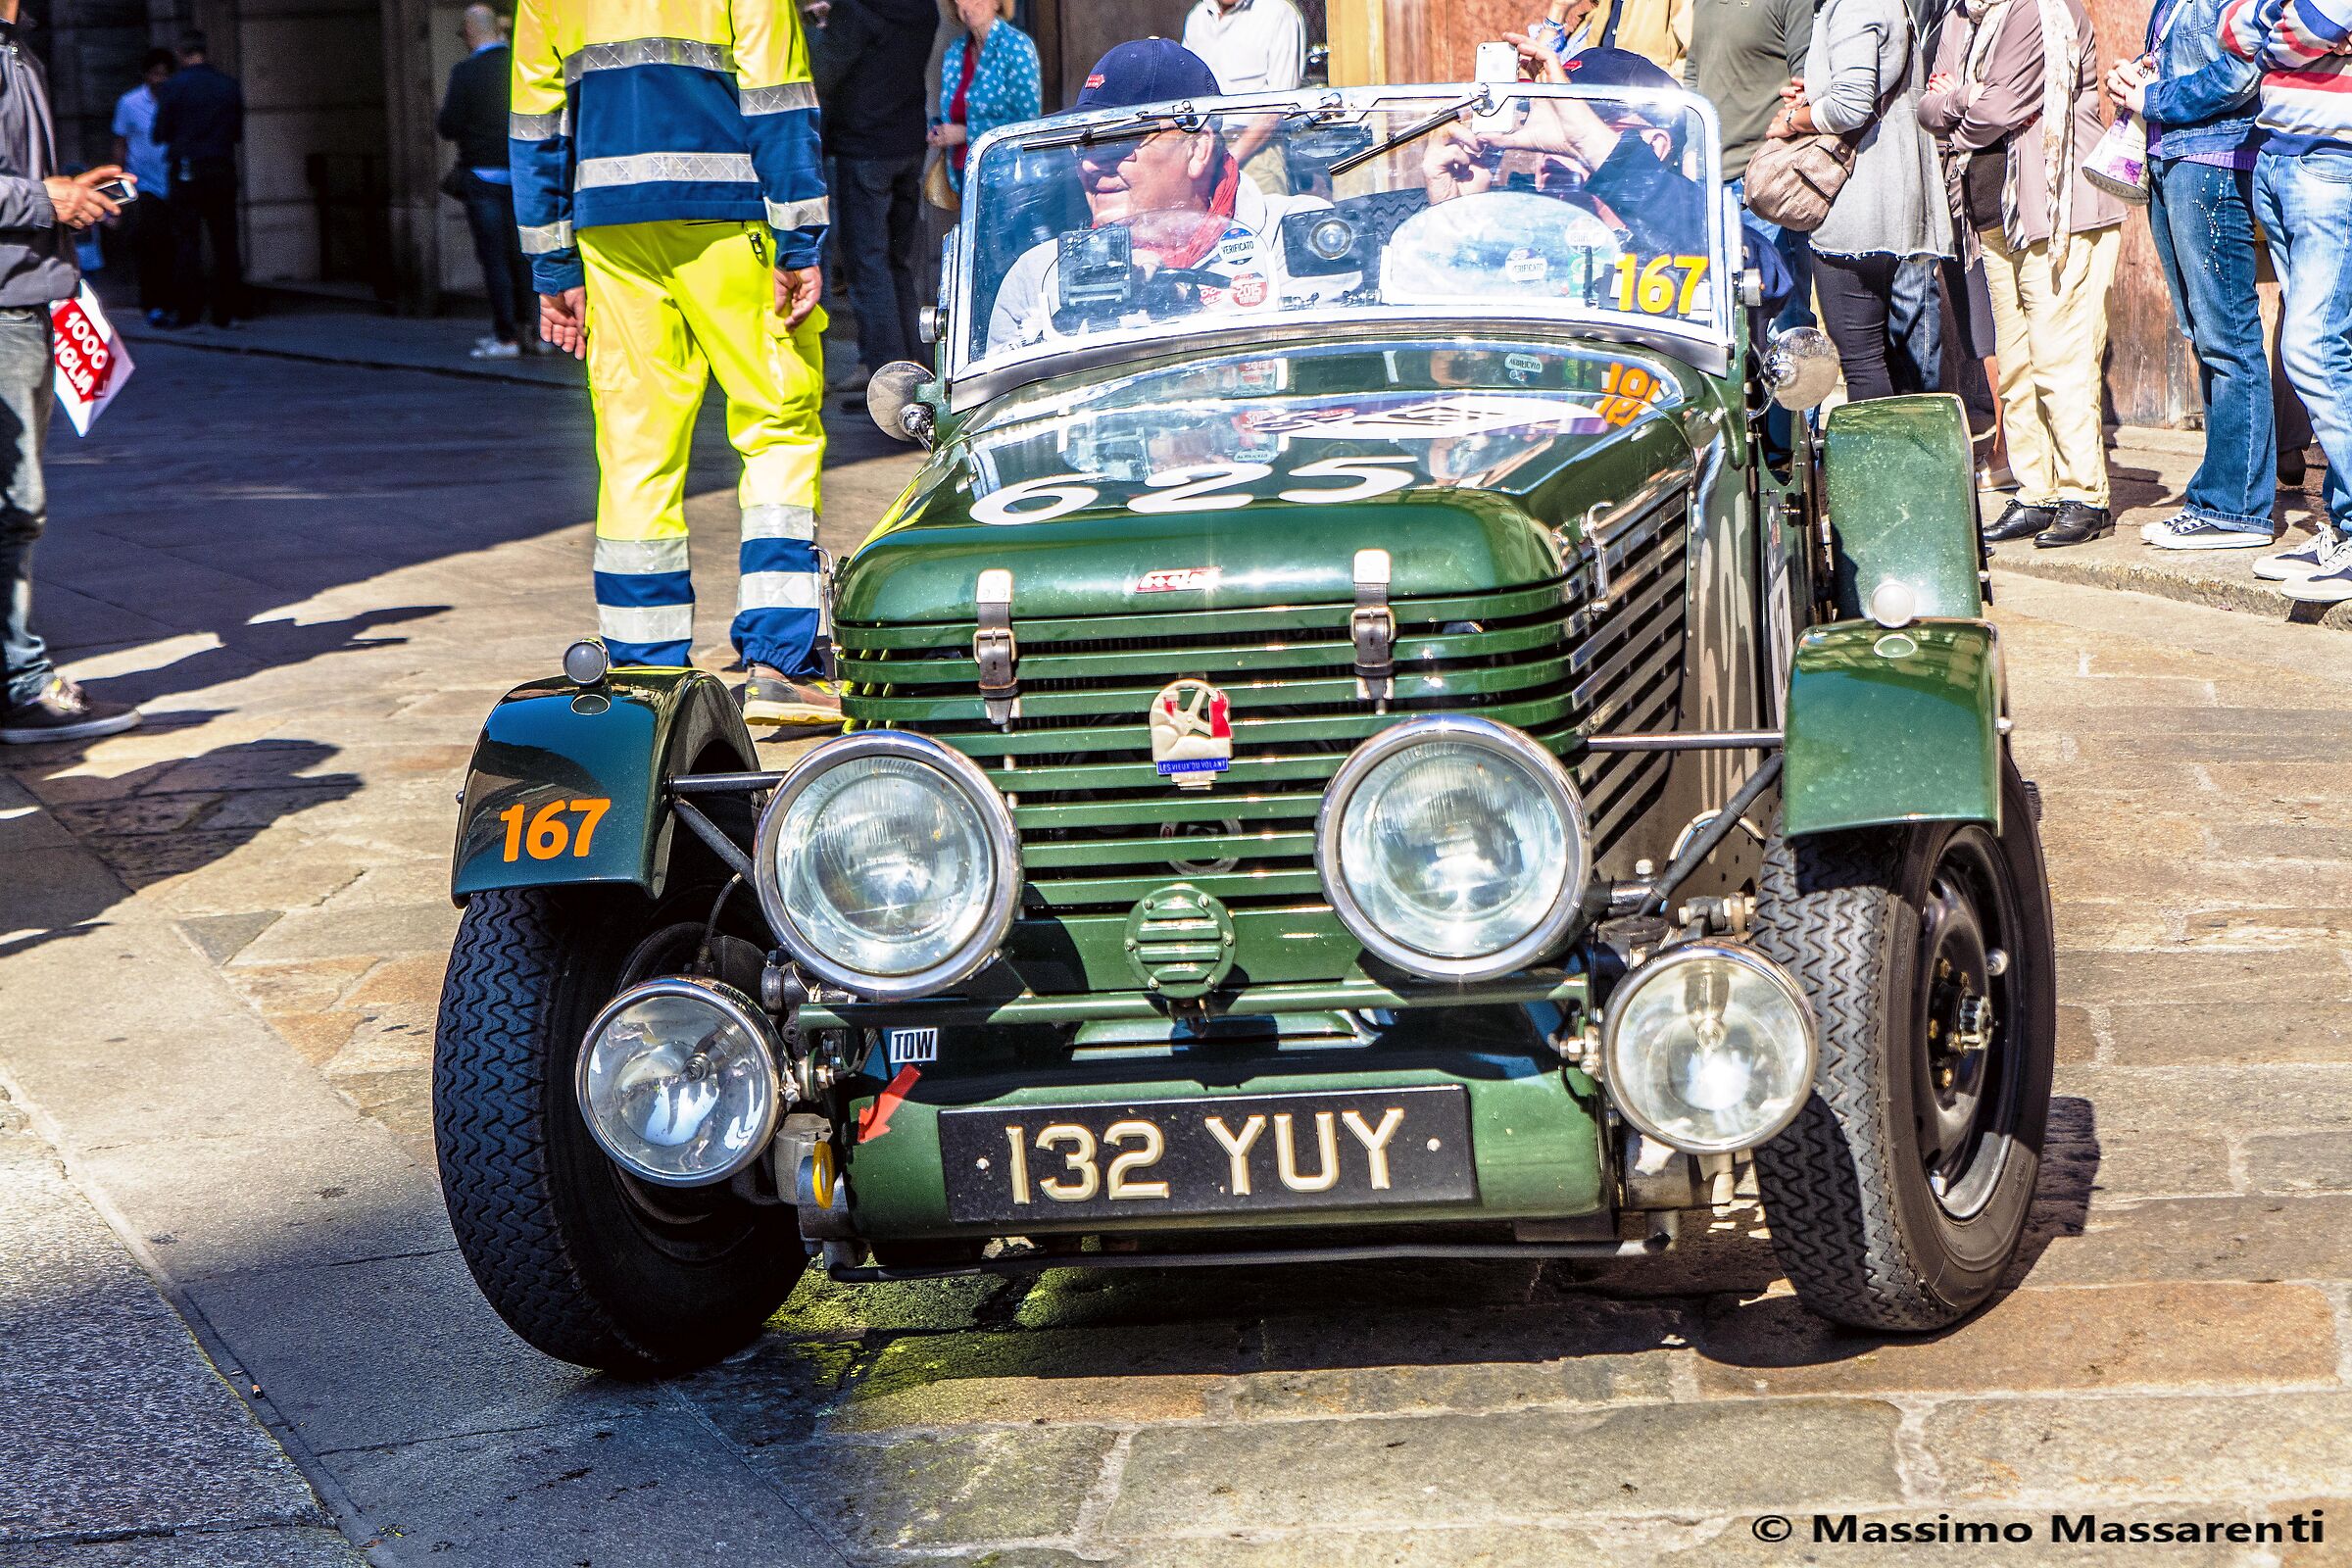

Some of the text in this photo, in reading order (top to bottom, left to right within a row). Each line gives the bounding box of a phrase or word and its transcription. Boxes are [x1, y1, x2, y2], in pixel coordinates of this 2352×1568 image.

[1221, 240, 1254, 255] VERIFICATO
[1614, 253, 1709, 315] 167
[65, 312, 110, 370] 1000
[969, 457, 1419, 525] 625
[1159, 760, 1226, 772] LES VIEUX DU VOLANT
[500, 798, 612, 862] 167
[894, 1030, 934, 1060] TOW
[1005, 1108, 1404, 1205] 132 YUY
